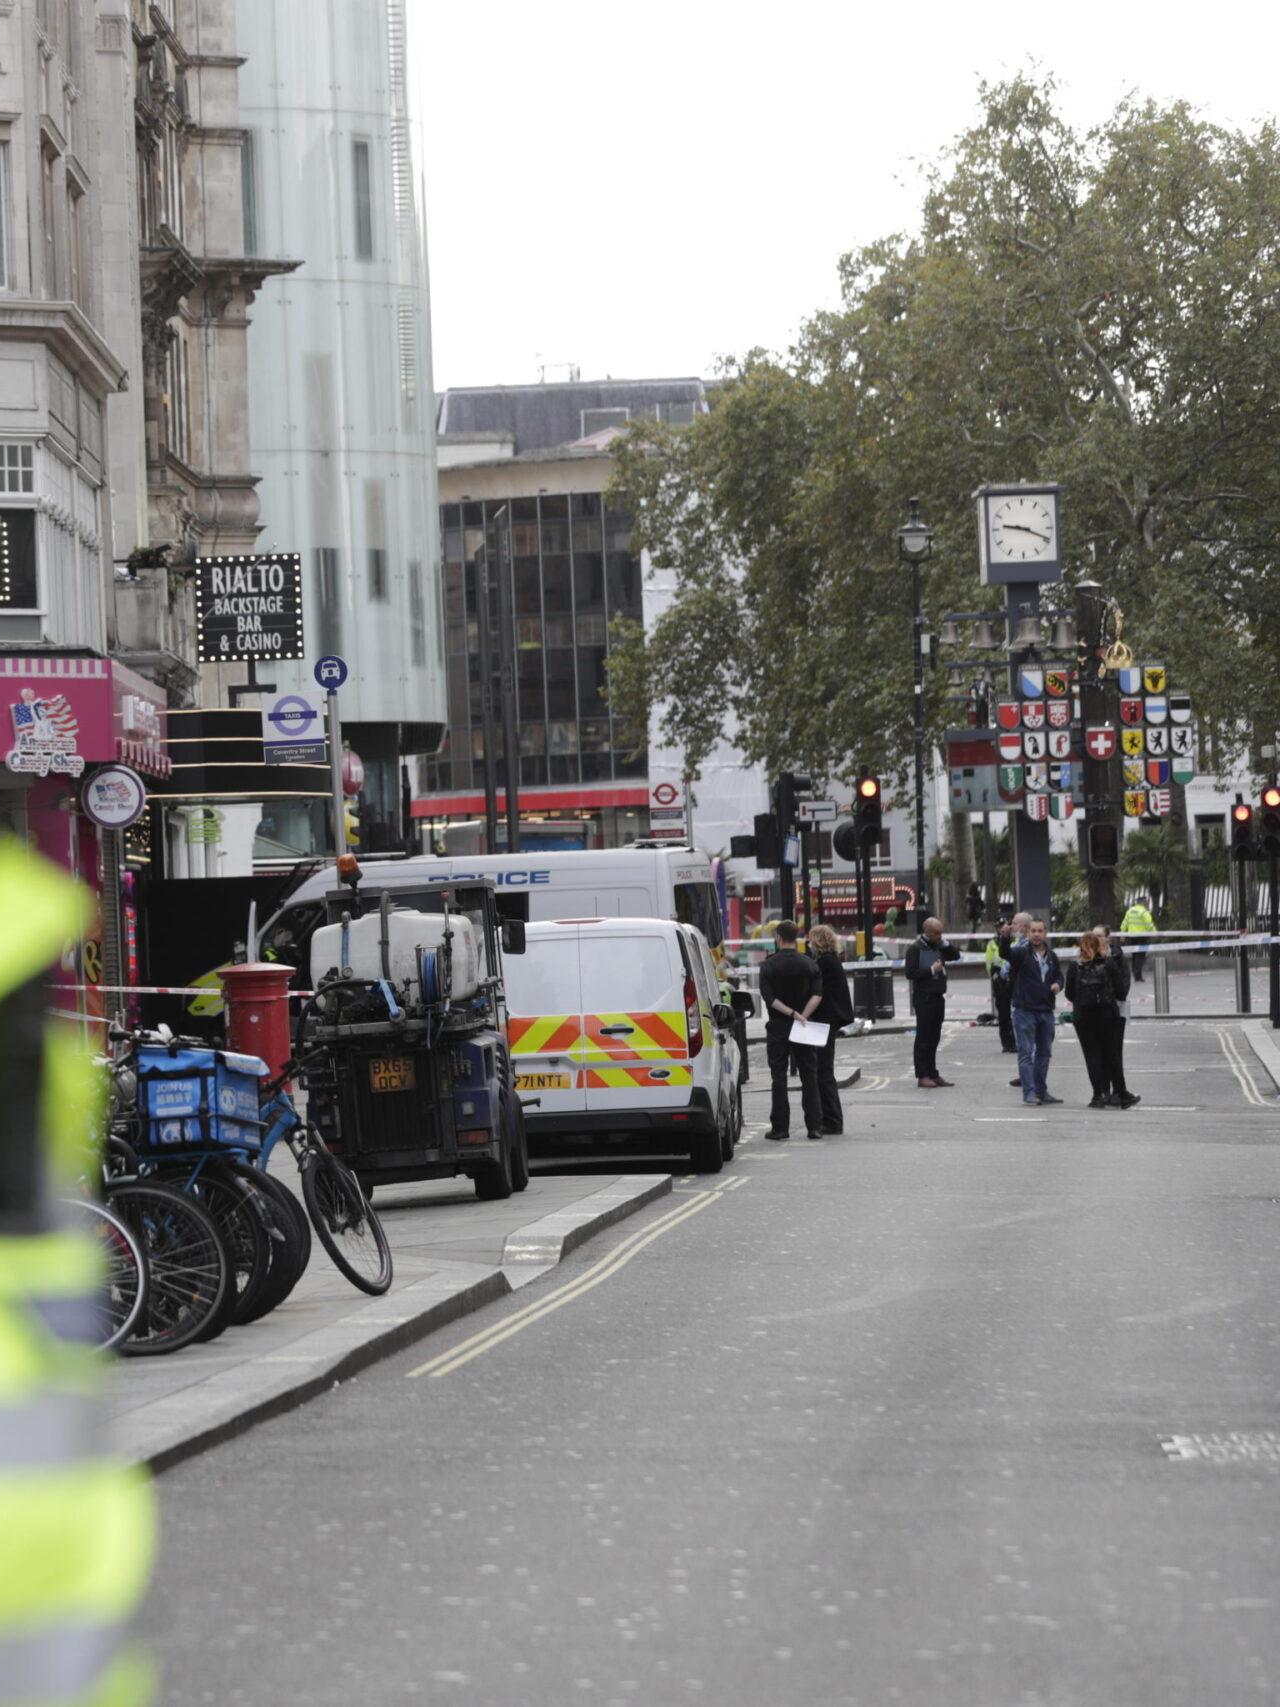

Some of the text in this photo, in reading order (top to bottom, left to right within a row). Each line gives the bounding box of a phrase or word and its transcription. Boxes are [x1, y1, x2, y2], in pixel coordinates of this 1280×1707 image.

[211, 564, 284, 595] RIALTO
[214, 596, 284, 616] BACKSTAGE
[237, 615, 262, 633] BAR
[220, 632, 281, 652] & CASINO
[428, 870, 551, 886] ICE
[537, 1073, 563, 1087] NTT
